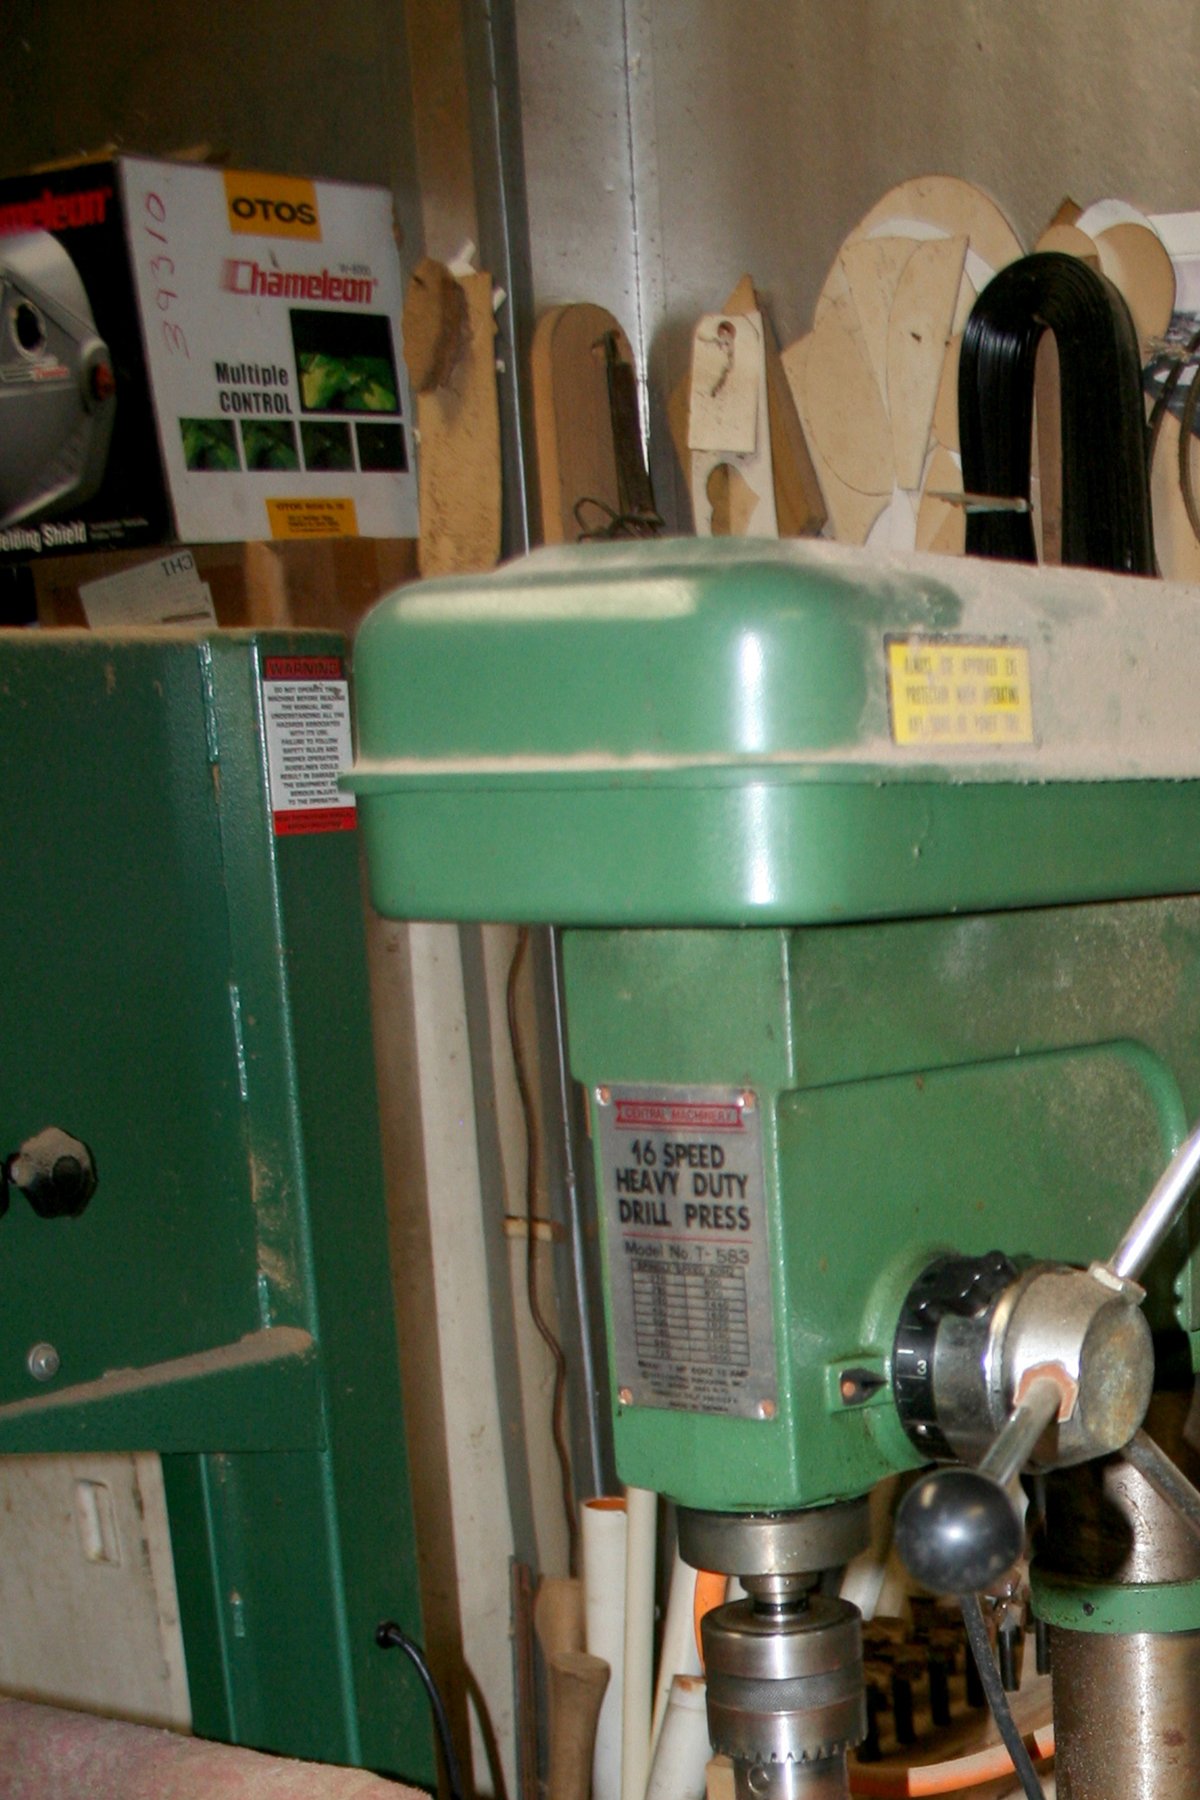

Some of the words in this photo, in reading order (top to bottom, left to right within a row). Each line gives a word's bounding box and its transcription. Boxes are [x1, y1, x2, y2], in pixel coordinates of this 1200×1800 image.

[232, 198, 317, 226] OTOS
[221, 258, 373, 304] Chameleon
[214, 361, 289, 388] Multiple
[219, 392, 293, 415] CONTROL
[41, 520, 88, 547] Shield
[664, 1142, 725, 1169] SPEED
[616, 1168, 680, 1196] HEAVY
[693, 1172, 749, 1199] DUTY
[619, 1199, 673, 1226] DRILL
[685, 1203, 751, 1231] PRESS
[625, 1240, 664, 1256] Model
